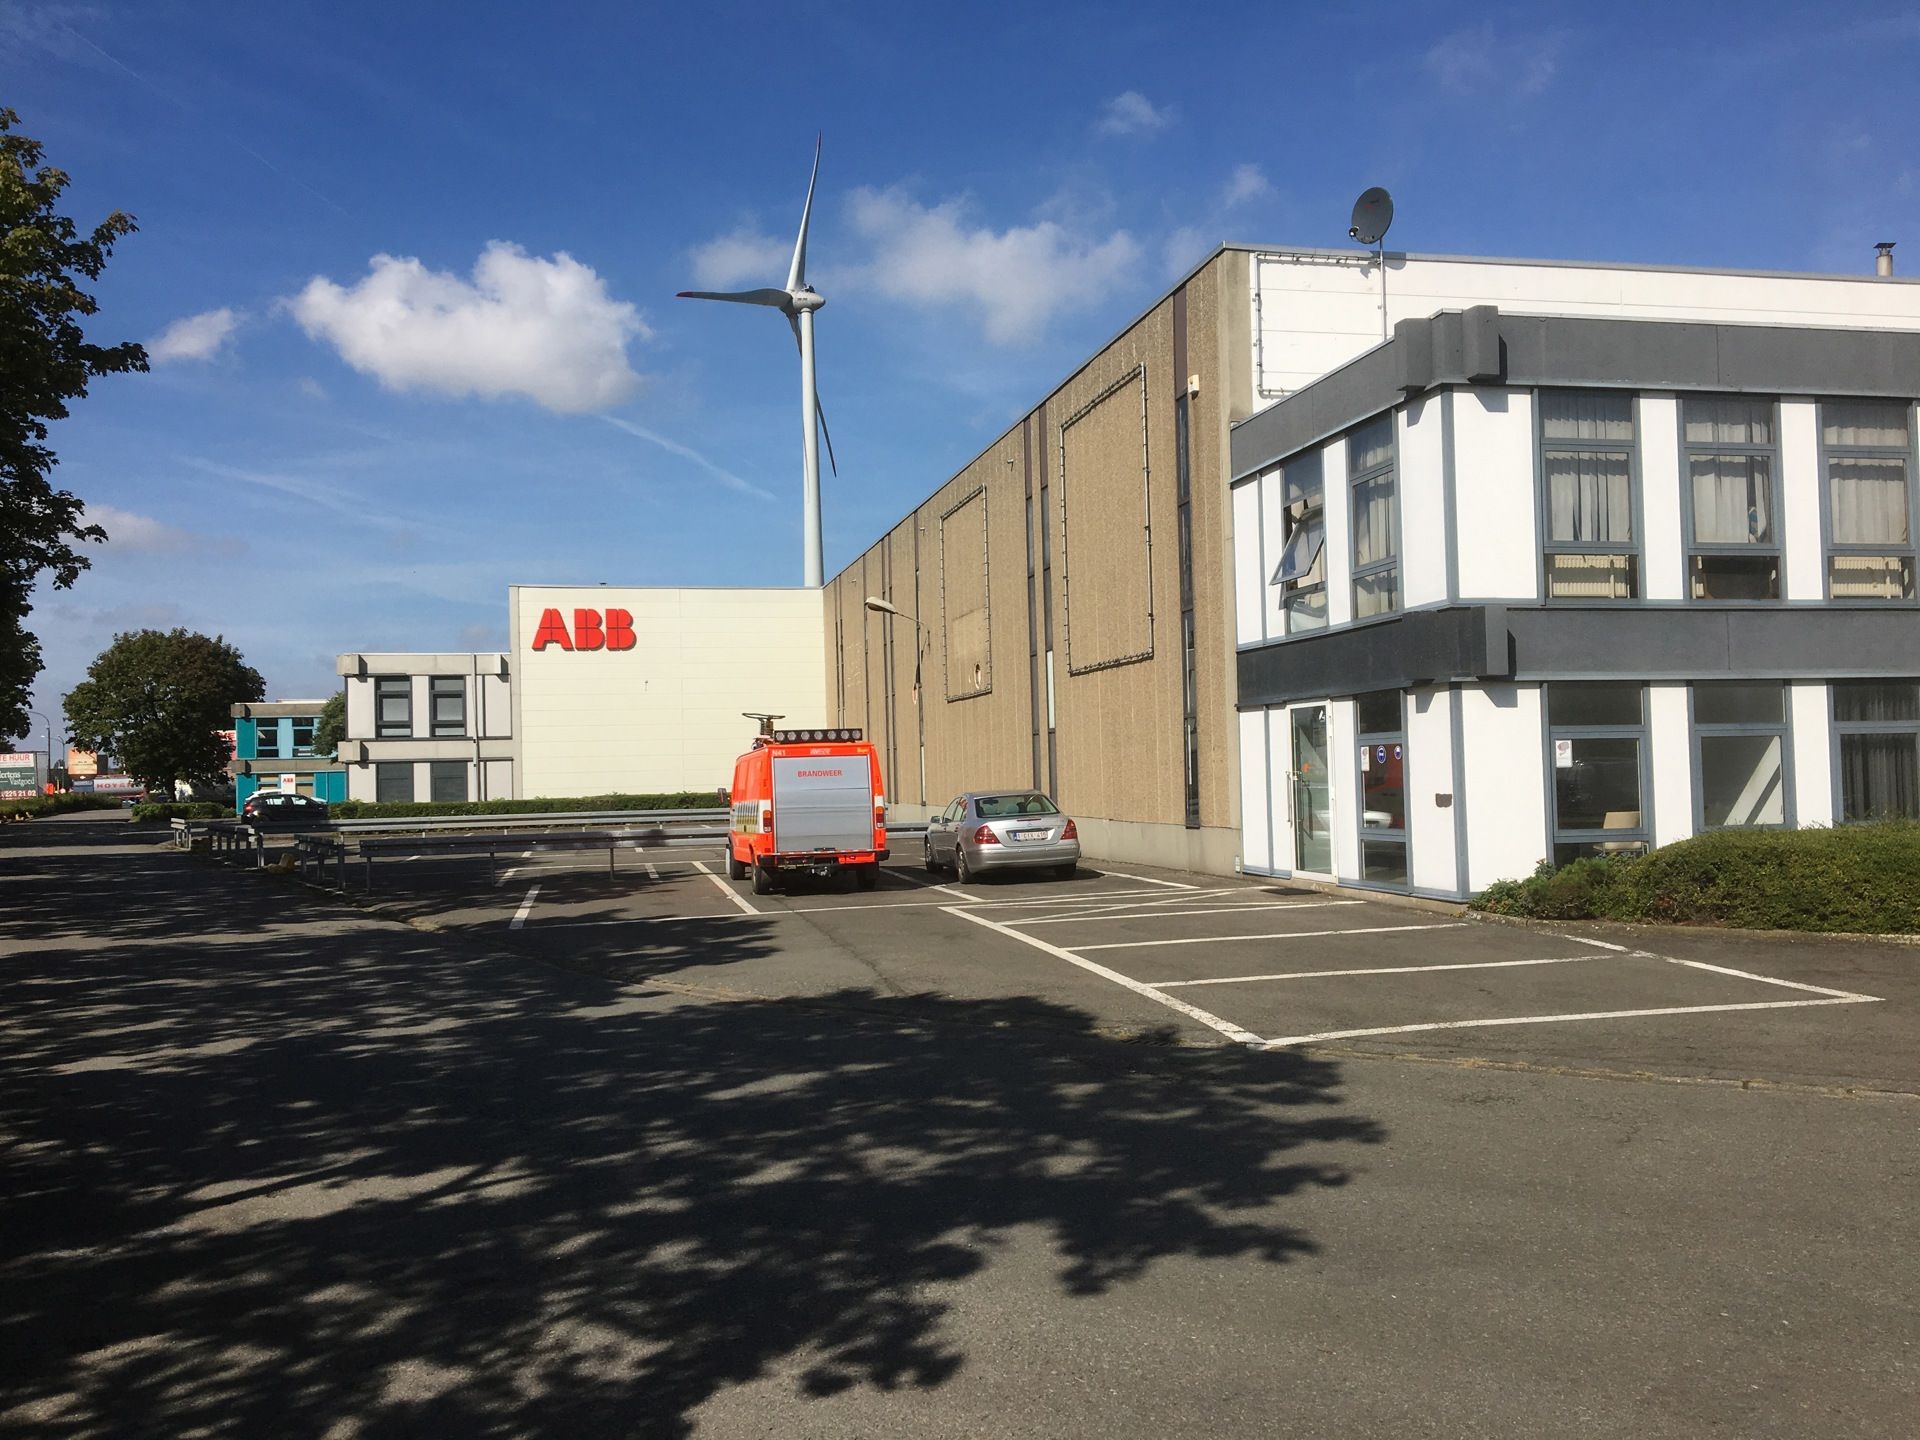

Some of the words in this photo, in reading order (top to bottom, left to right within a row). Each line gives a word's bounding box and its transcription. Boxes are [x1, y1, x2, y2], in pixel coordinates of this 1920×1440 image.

[531, 608, 637, 651] ABB
[9, 753, 30, 761] HUUR
[10, 776, 35, 787] Vastgoed
